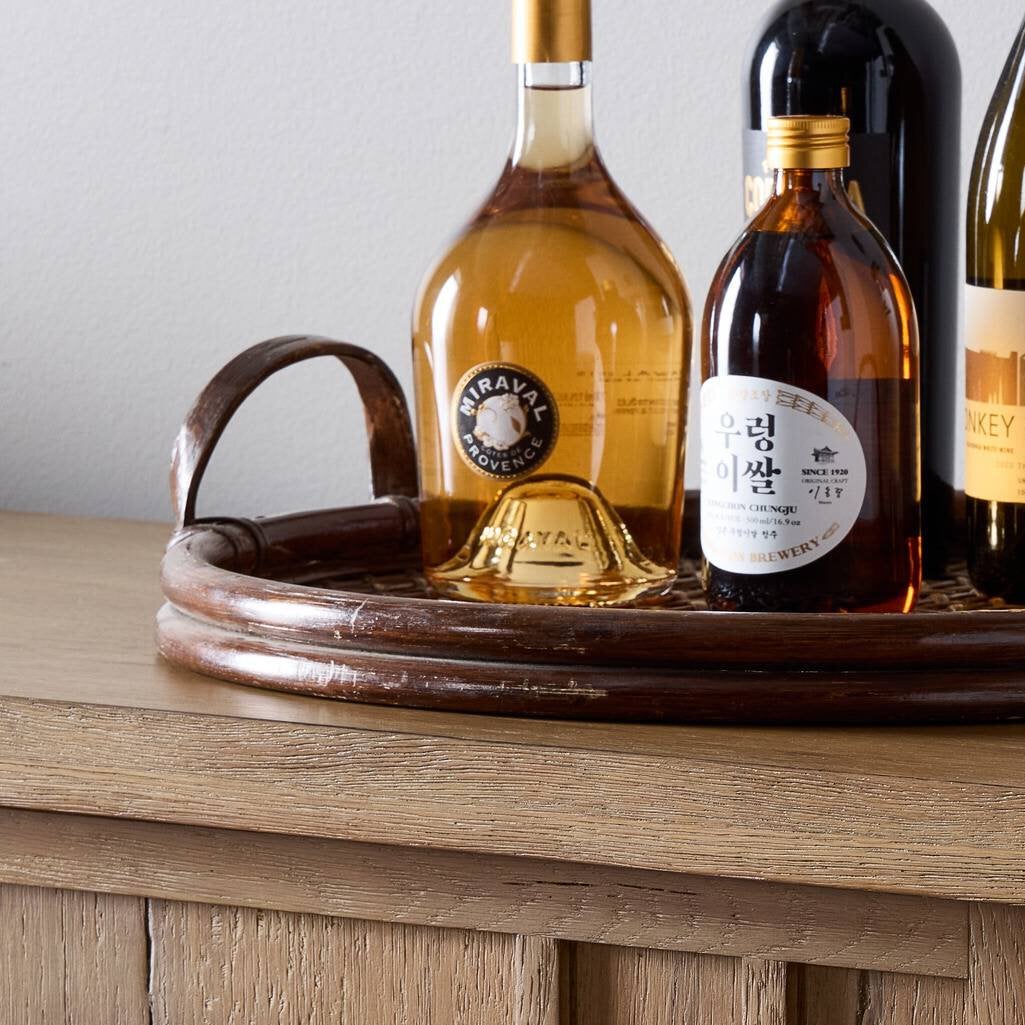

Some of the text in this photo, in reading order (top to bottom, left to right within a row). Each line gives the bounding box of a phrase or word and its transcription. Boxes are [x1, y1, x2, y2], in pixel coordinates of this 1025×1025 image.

[459, 375, 549, 422] MIRAVAL
[714, 411, 776, 453] 우렁
[462, 433, 544, 471] PROVENCE
[715, 453, 782, 496] 이쌀
[801, 468, 849, 476] SINCE 1920
[749, 504, 798, 516] CHUNGJU
[749, 536, 821, 562] BREWERY
